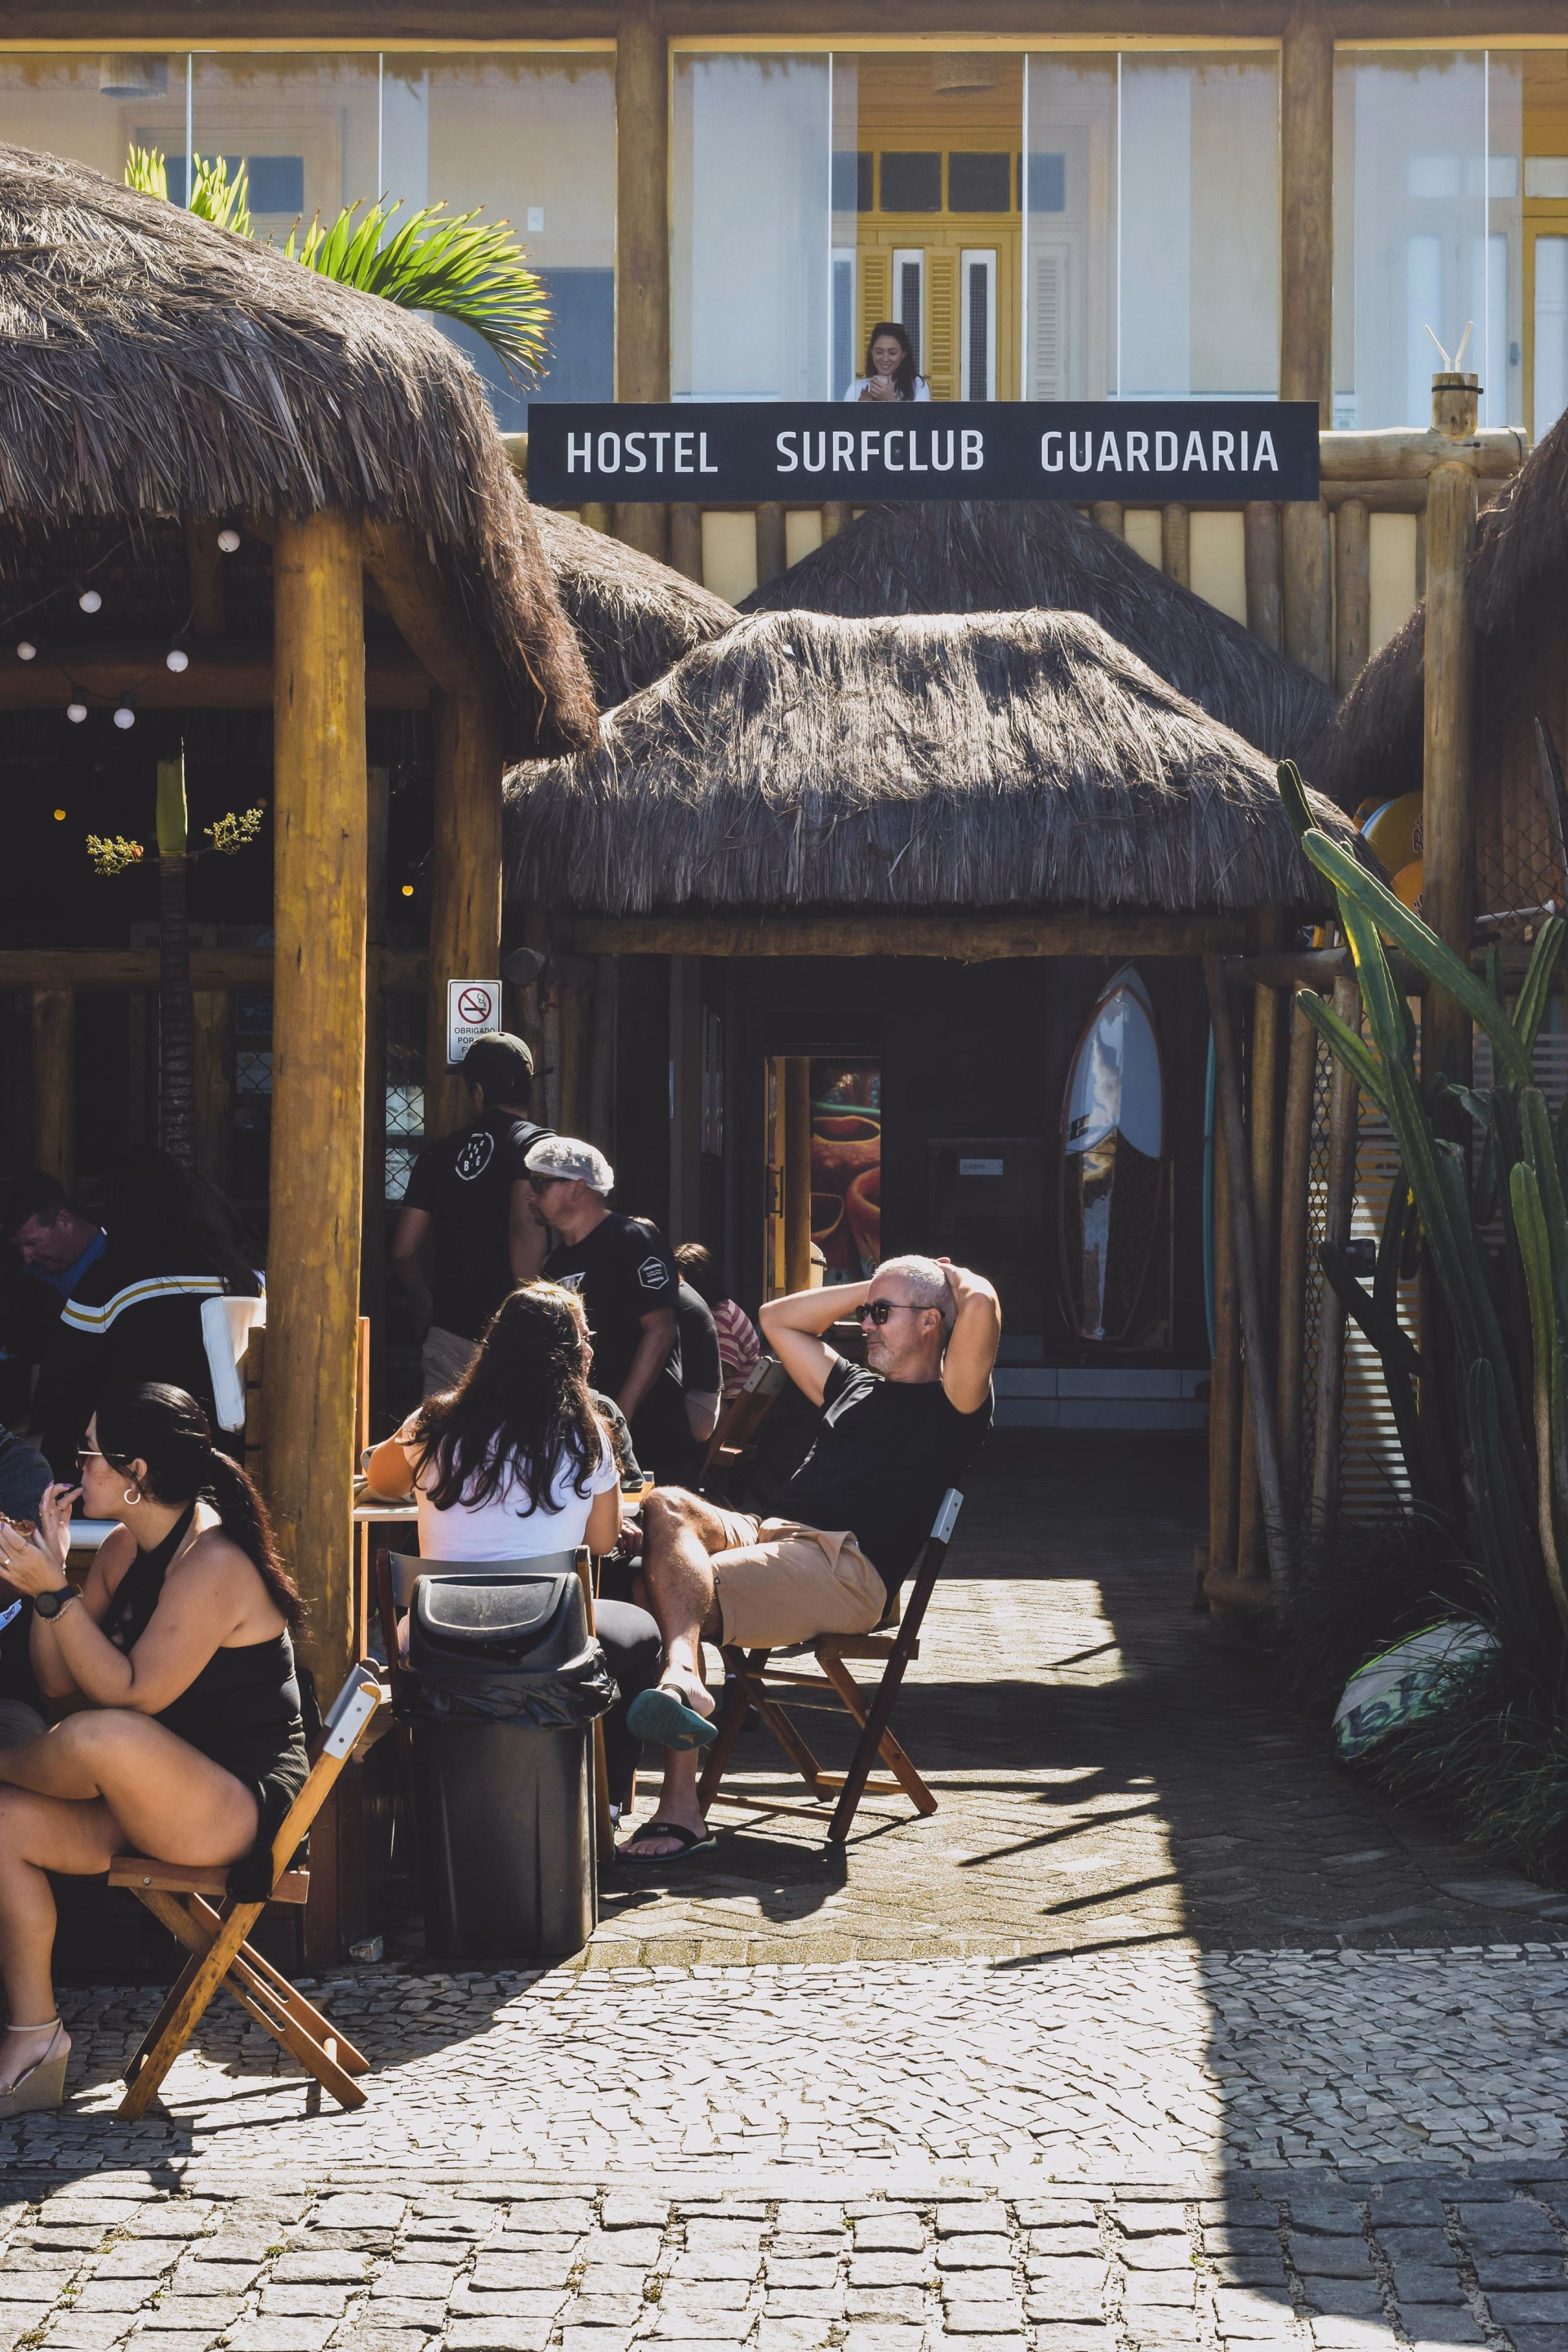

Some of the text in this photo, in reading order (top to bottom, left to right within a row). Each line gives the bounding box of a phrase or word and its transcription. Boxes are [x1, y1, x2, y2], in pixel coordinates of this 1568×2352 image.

[567, 430, 1279, 474] HOSTEL SURFCLUB GUARDARIA
[454, 1027, 496, 1035] OBRIGADO
